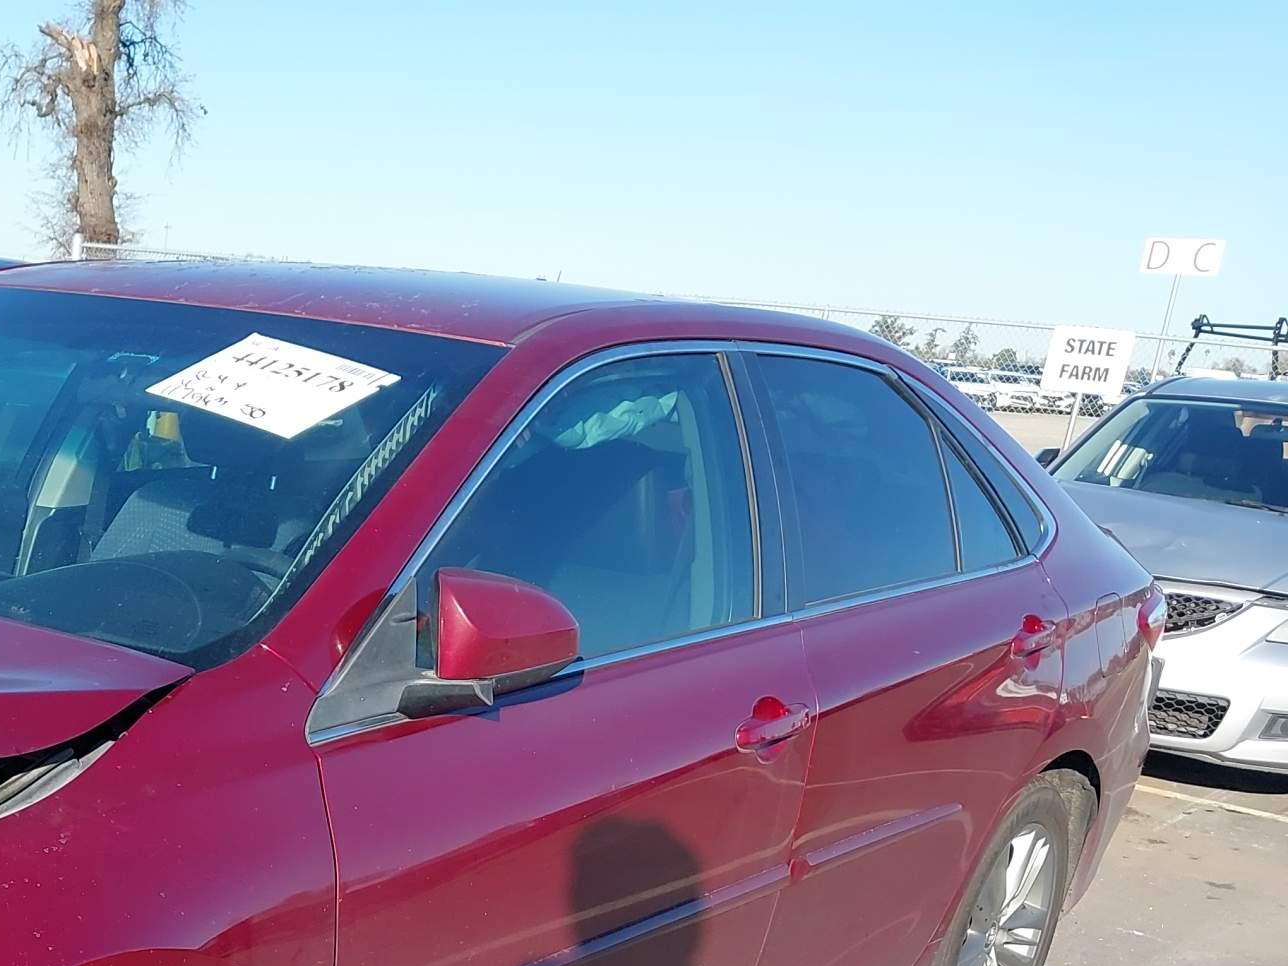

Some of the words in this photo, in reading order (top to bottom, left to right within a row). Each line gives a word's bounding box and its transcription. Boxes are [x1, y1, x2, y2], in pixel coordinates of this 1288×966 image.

[1146, 240, 1170, 270] D
[1193, 242, 1216, 272] C
[1064, 338, 1117, 357] STATE
[232, 352, 354, 393] 44125178
[1058, 363, 1110, 383] FARM
